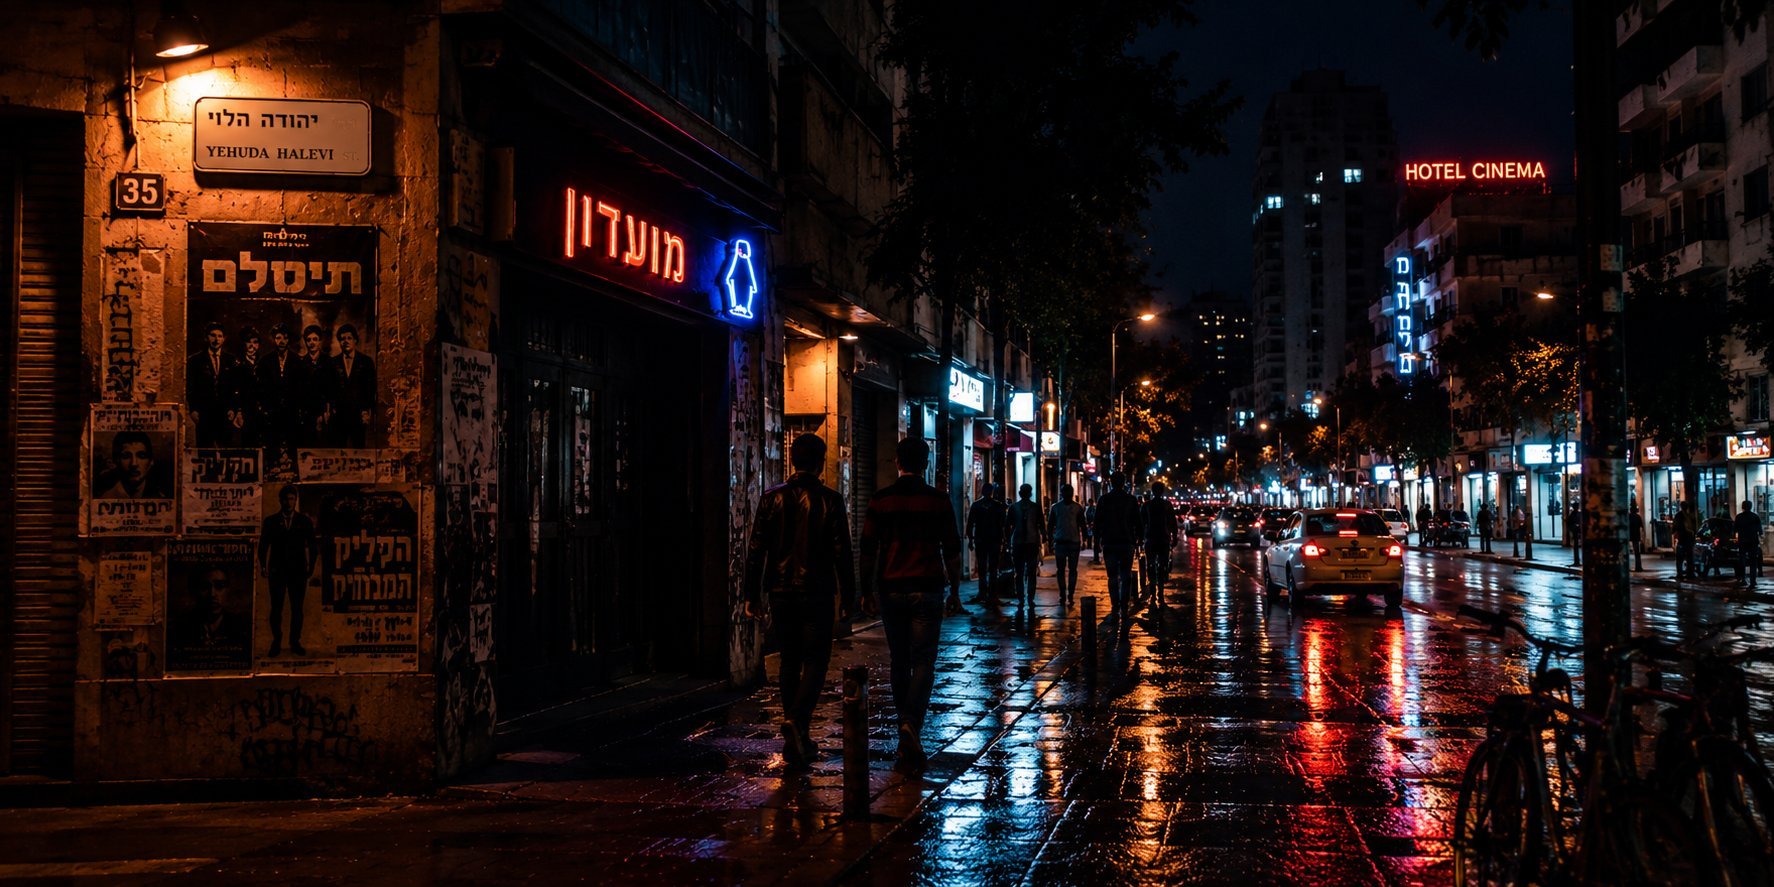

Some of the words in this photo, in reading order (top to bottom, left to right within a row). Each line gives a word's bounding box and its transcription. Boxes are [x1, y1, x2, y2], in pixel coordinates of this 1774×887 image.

[207, 108, 250, 128] הלוי
[260, 112, 319, 129] יהודה
[205, 145, 270, 160] YEHUDA
[276, 147, 334, 161] HALEVI
[1404, 162, 1467, 181] HOTEL
[1471, 160, 1547, 180] CINEMA
[122, 177, 159, 206] 35
[563, 186, 687, 284] מועדון
[333, 528, 412, 569] הקליק
